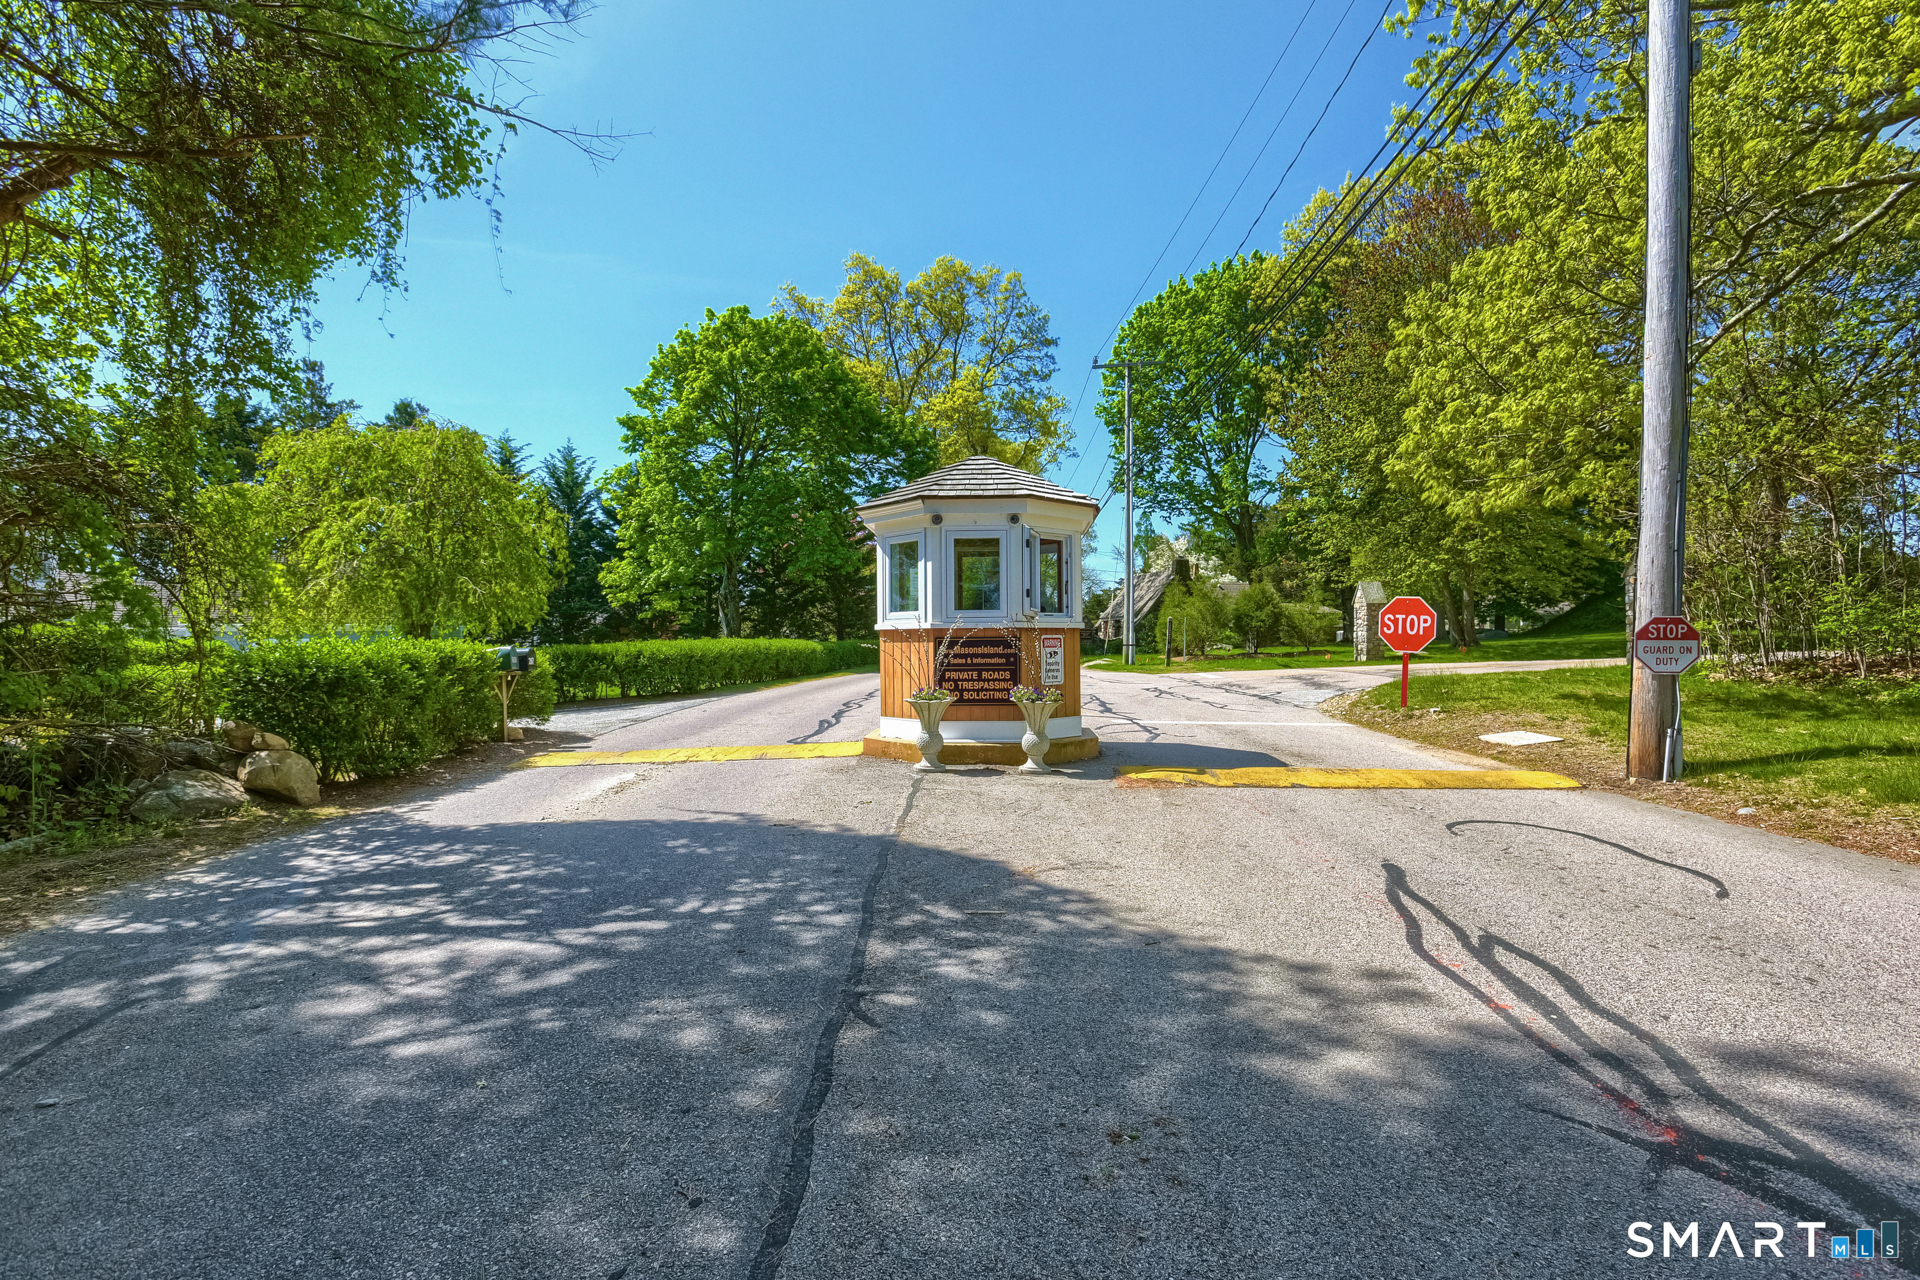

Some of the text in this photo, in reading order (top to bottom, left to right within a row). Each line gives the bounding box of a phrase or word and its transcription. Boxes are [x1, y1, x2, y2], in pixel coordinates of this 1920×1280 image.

[1383, 614, 1432, 635] STOP
[1648, 624, 1688, 638] STOP
[940, 645, 1016, 654] ww.MasonsIsland.com
[1643, 645, 1693, 655] GUARD ON
[1655, 657, 1680, 666] DUTY
[945, 671, 1011, 680] PRIVATE ROADS
[942, 681, 1014, 690] NO TRESPASSING
[948, 691, 1009, 700] NO SOLICITING
